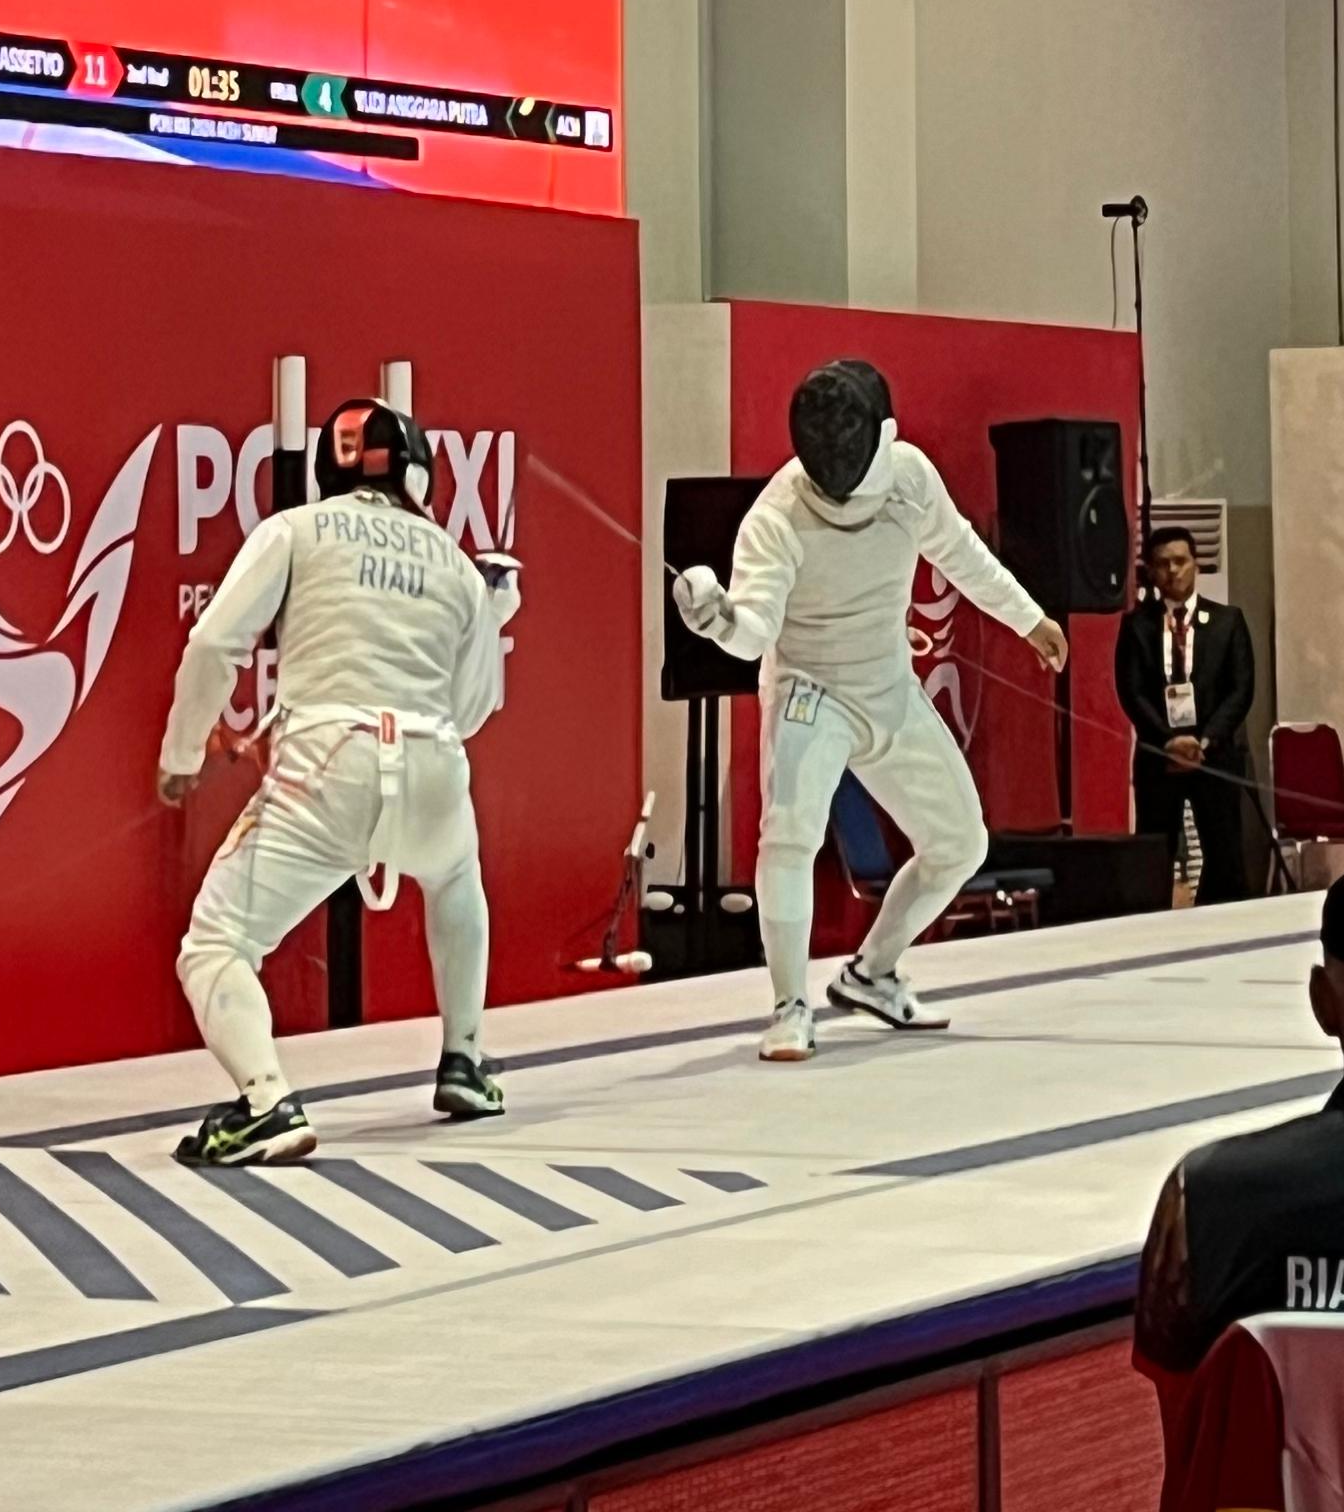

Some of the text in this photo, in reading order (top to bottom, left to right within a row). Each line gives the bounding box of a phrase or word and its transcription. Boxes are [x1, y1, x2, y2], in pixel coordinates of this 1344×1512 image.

[84, 54, 107, 85] 11
[188, 66, 240, 101] 01:35
[359, 553, 425, 599] RIAU
